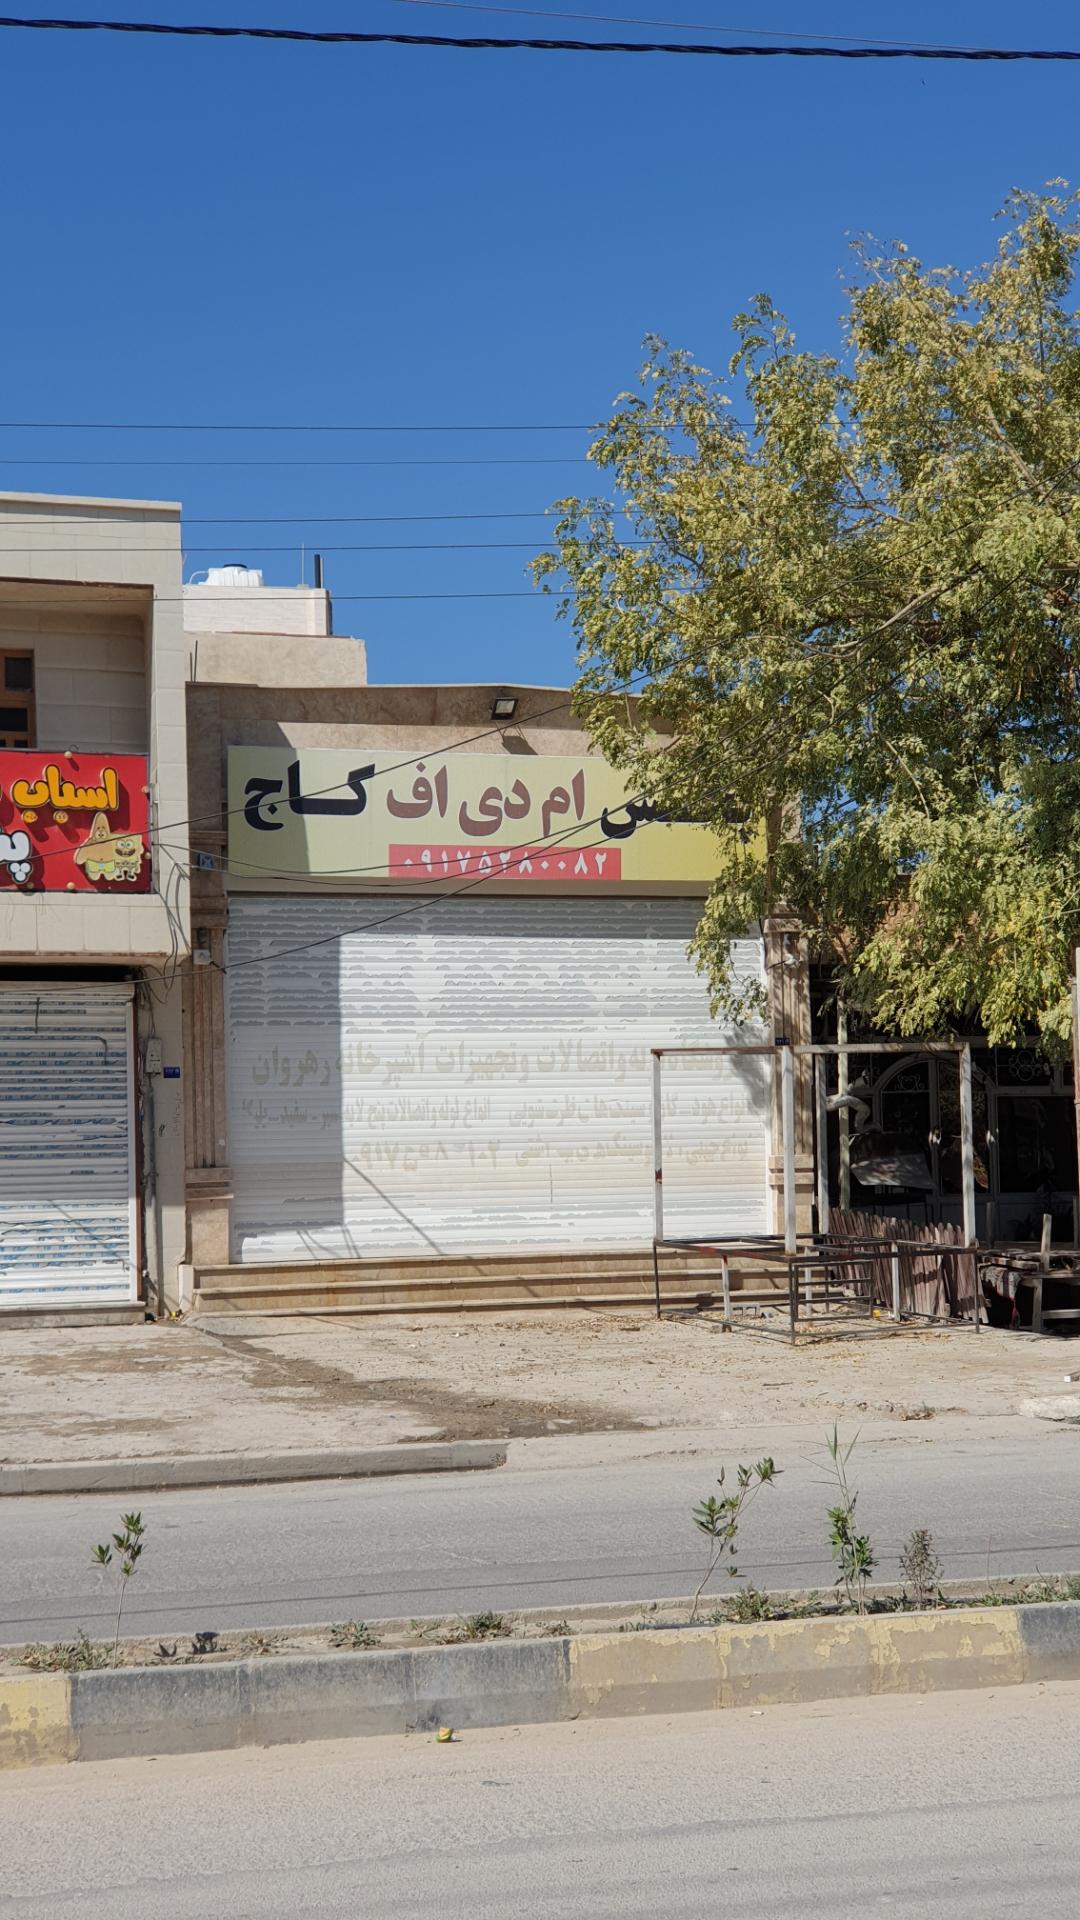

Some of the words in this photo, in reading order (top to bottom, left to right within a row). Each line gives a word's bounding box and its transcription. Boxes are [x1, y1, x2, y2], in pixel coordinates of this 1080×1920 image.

[244, 759, 375, 831] کاج
[386, 761, 448, 819] اف
[459, 778, 531, 837] دی
[542, 768, 585, 838] ام
